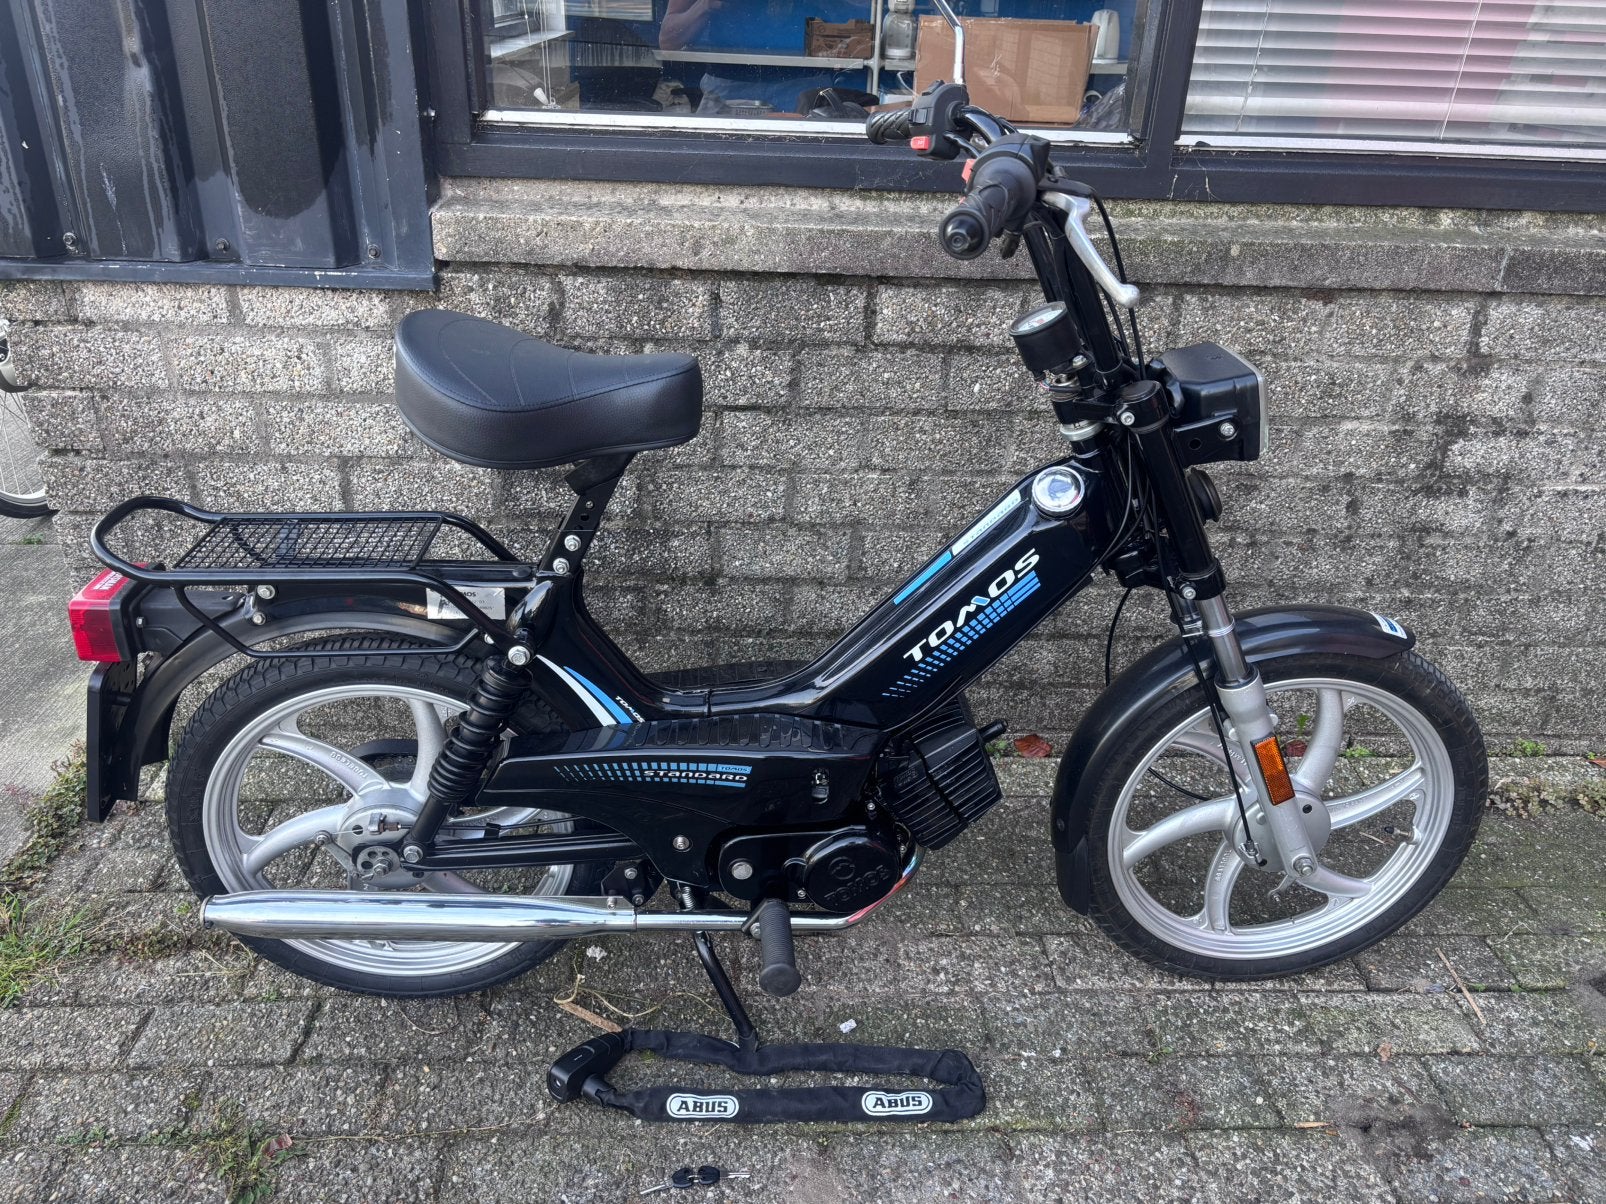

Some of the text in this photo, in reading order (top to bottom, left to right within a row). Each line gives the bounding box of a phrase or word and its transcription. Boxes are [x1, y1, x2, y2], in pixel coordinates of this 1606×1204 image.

[903, 548, 1040, 662] TOMOS
[615, 695, 646, 723] TOMOS
[676, 1100, 729, 1113] ABUS
[872, 1096, 923, 1108] ABUS
